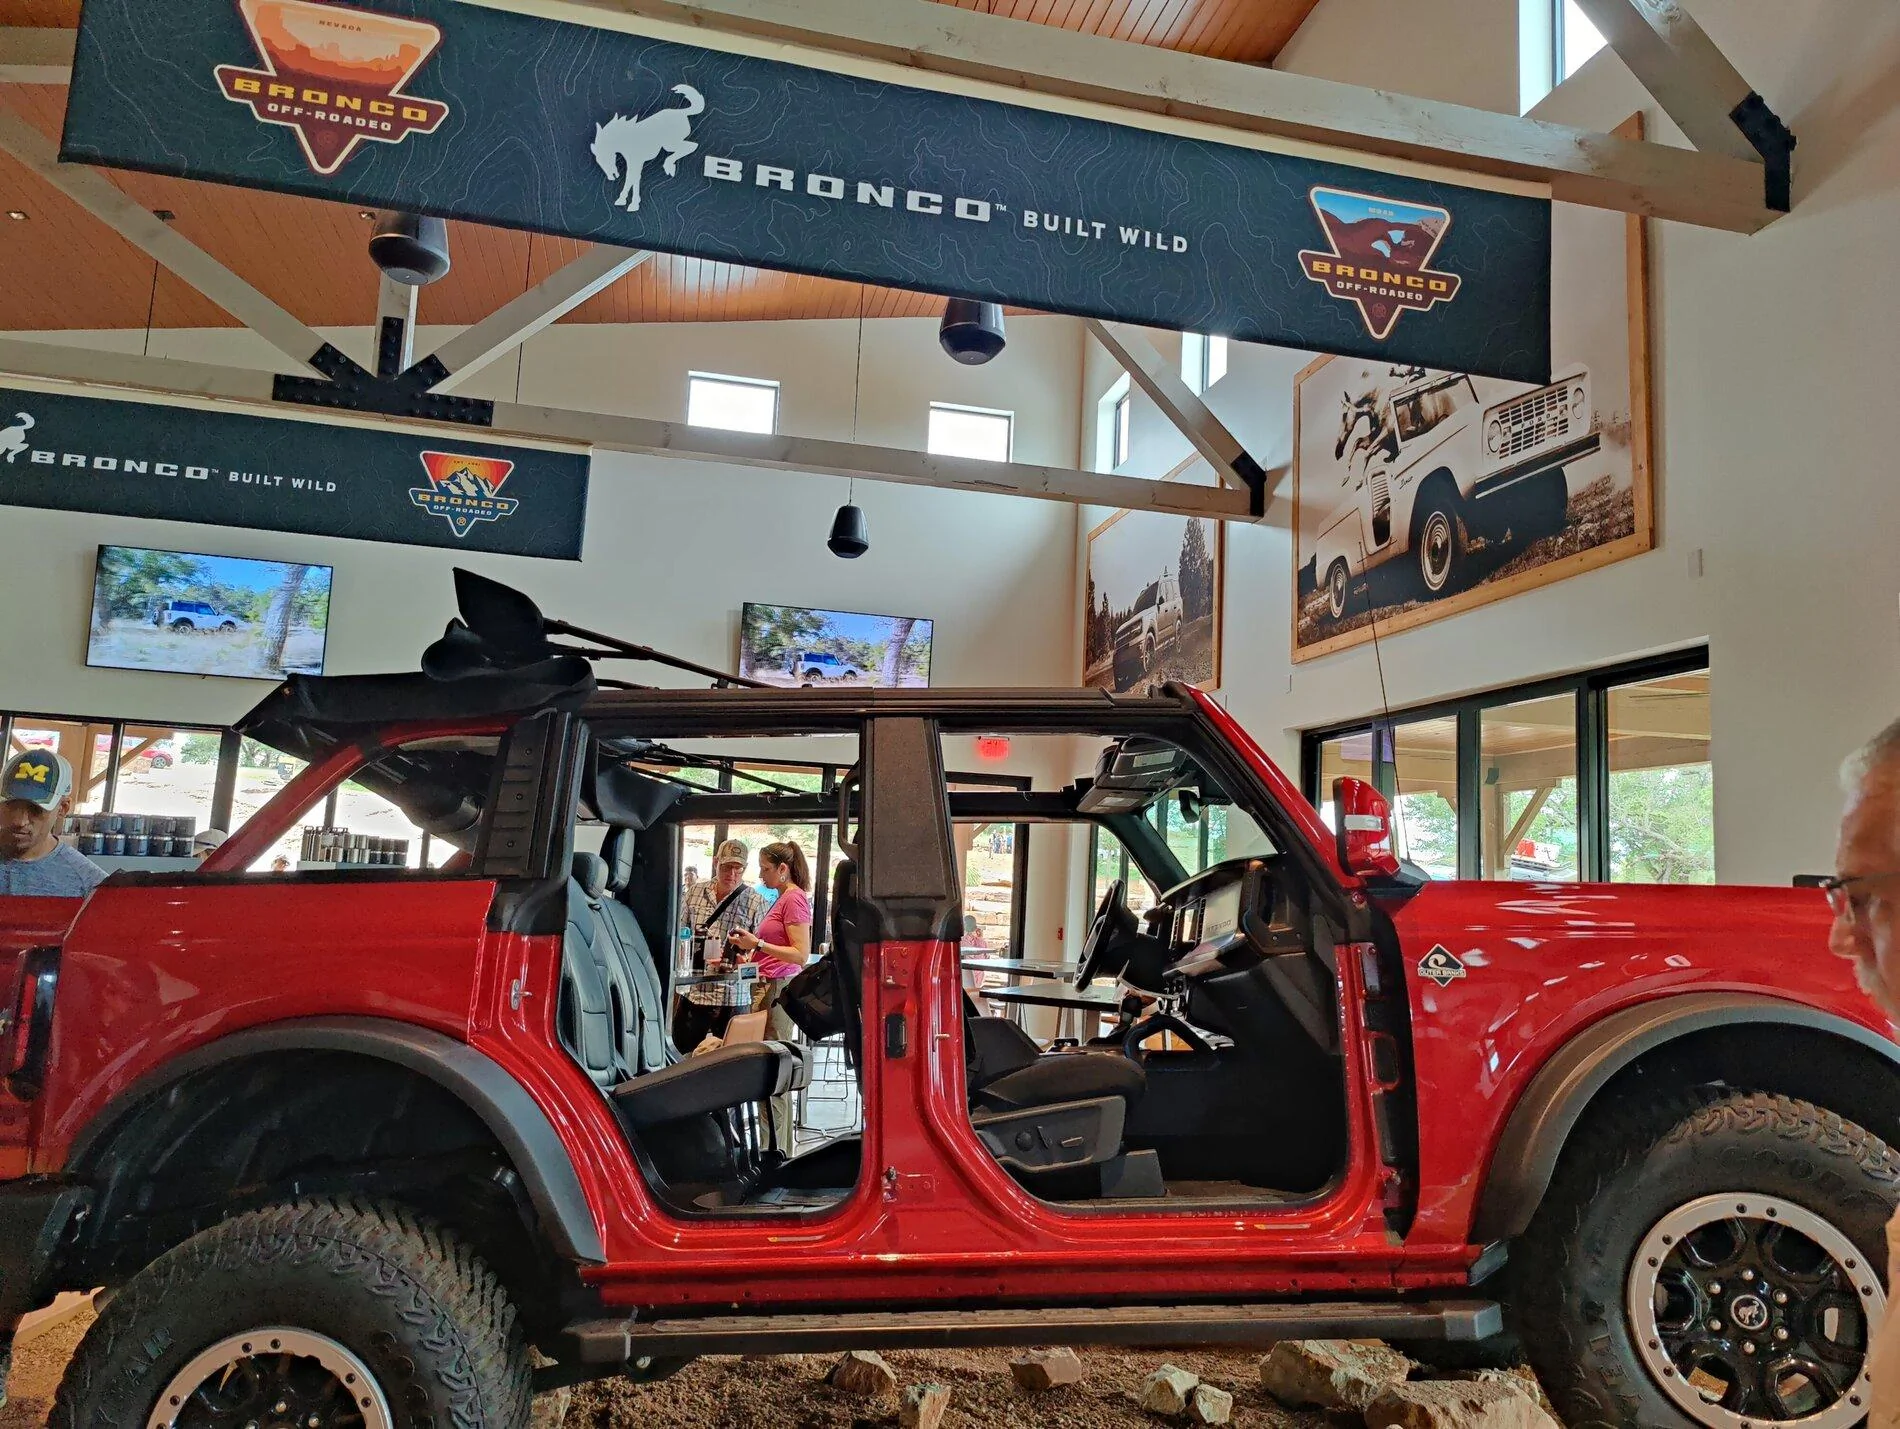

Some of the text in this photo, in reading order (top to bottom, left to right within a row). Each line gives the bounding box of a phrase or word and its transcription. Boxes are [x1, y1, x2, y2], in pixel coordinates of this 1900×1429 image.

[318, 19, 363, 32] NEVADA
[234, 77, 428, 123] BRONCO
[267, 103, 392, 132] OFF-ROADEO
[1023, 210, 1106, 240] BUILT
[1119, 226, 1188, 254] WILD
[1312, 260, 1447, 292] BRONCO
[1336, 281, 1424, 302] OFF-ROADEO
[228, 471, 284, 488] BUILT
[291, 477, 337, 493] WILD
[418, 493, 509, 510] BRONCO
[433, 504, 492, 516] OFF-ROADEO
[15, 762, 50, 783] M
